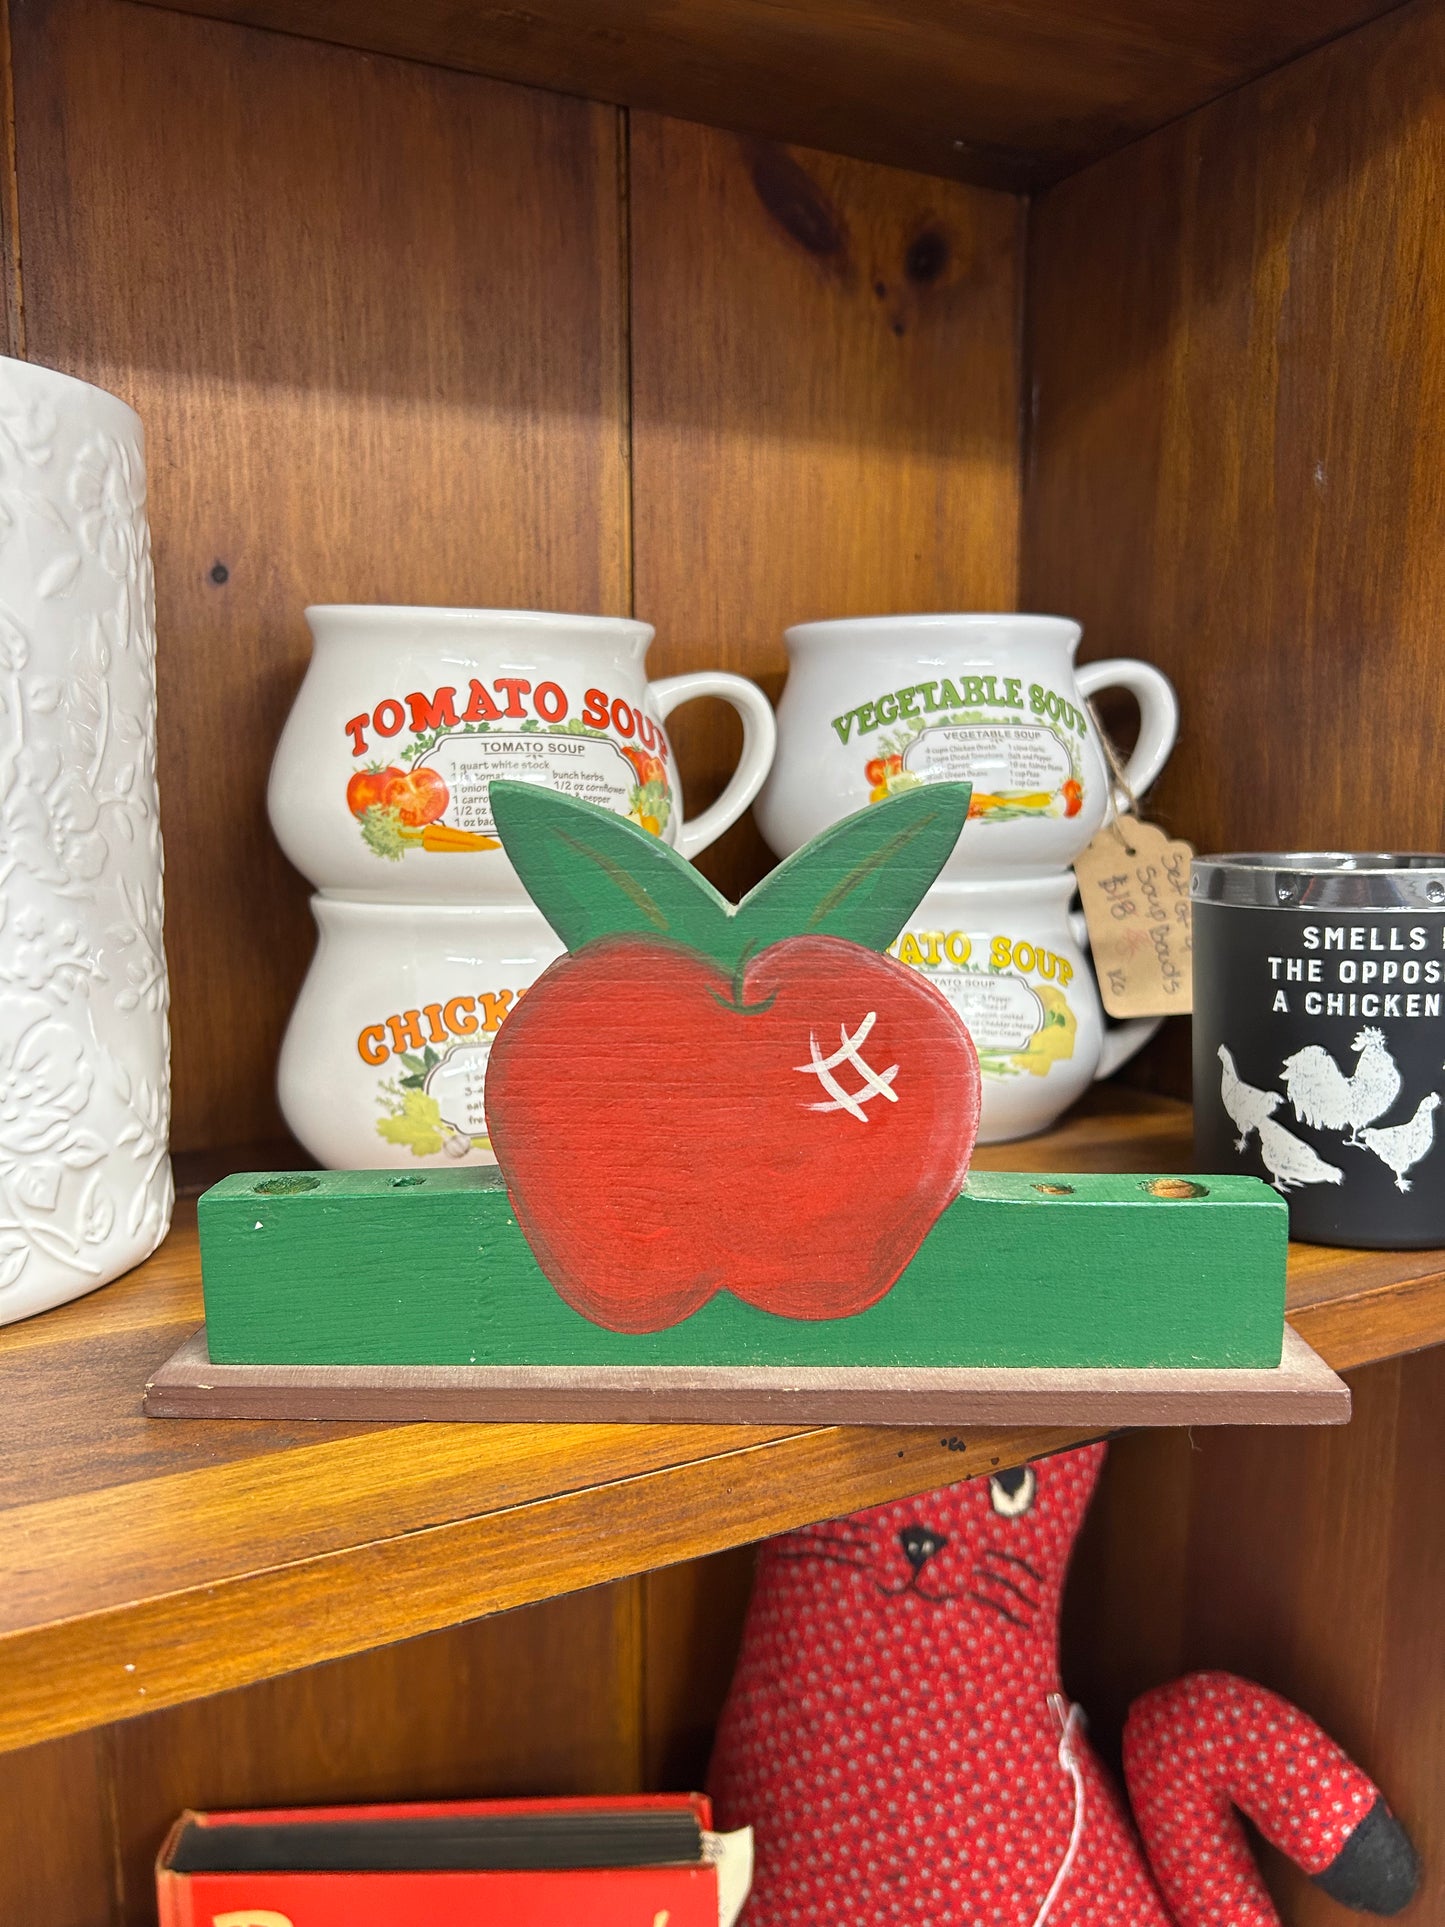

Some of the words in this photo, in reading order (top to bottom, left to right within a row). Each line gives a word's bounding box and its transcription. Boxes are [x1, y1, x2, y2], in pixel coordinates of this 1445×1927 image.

[831, 675, 1024, 745] VEGETABLE
[1028, 683, 1088, 740] SOUP
[345, 678, 568, 757] TOMATO
[944, 730, 1012, 740] VEGETABLE
[1014, 730, 1041, 739] SOUP
[482, 742, 543, 752] TOMATO
[548, 743, 585, 754] SOUP
[451, 762, 456, 771] 1
[460, 761, 489, 774] quart
[491, 760, 519, 769] white
[521, 760, 550, 769] stock
[552, 769, 579, 780] bunch
[580, 771, 605, 782] herbs
[452, 784, 457, 793] 1
[461, 784, 487, 793] onion
[553, 780, 572, 790] 1/2
[585, 783, 626, 795] cornflower
[453, 795, 458, 804] 1
[462, 796, 489, 804] carro
[453, 806, 473, 816] 1/2
[454, 818, 460, 827] 1
[463, 819, 475, 827] oz
[477, 817, 495, 826] bac
[1303, 926, 1427, 951] SMELLS
[886, 930, 972, 965] ATO
[990, 936, 1073, 987] SOUP
[1268, 957, 1323, 983] THE
[1339, 960, 1445, 985] OPPOS
[965, 979, 996, 989] SOUP
[1272, 989, 1290, 1013] A
[1305, 991, 1441, 1017] CHICKEN
[358, 989, 528, 1066] CHICK
